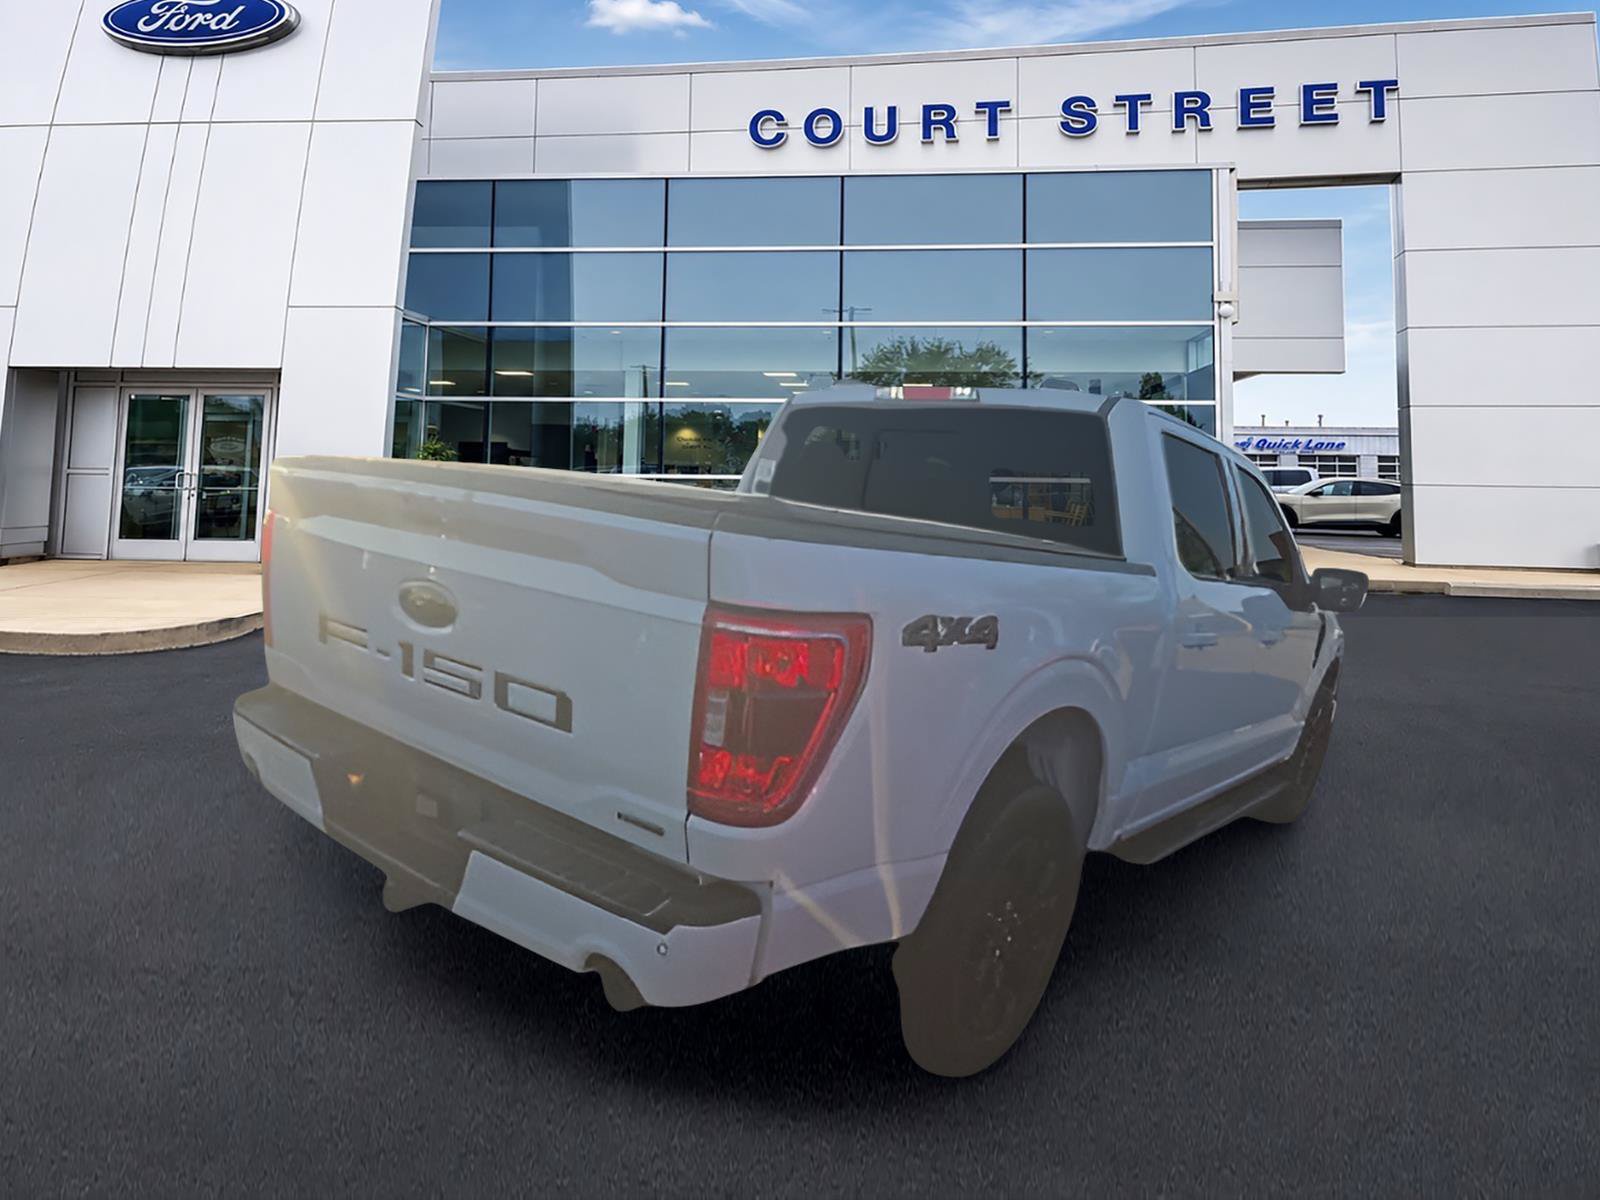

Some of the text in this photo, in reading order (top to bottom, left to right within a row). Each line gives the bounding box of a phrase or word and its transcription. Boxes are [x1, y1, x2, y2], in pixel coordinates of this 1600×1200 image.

[137, 0, 246, 32] Ford
[748, 78, 1399, 148] COURT STREET
[1255, 438, 1346, 451] Quick Lane
[318, 612, 574, 735] F-150
